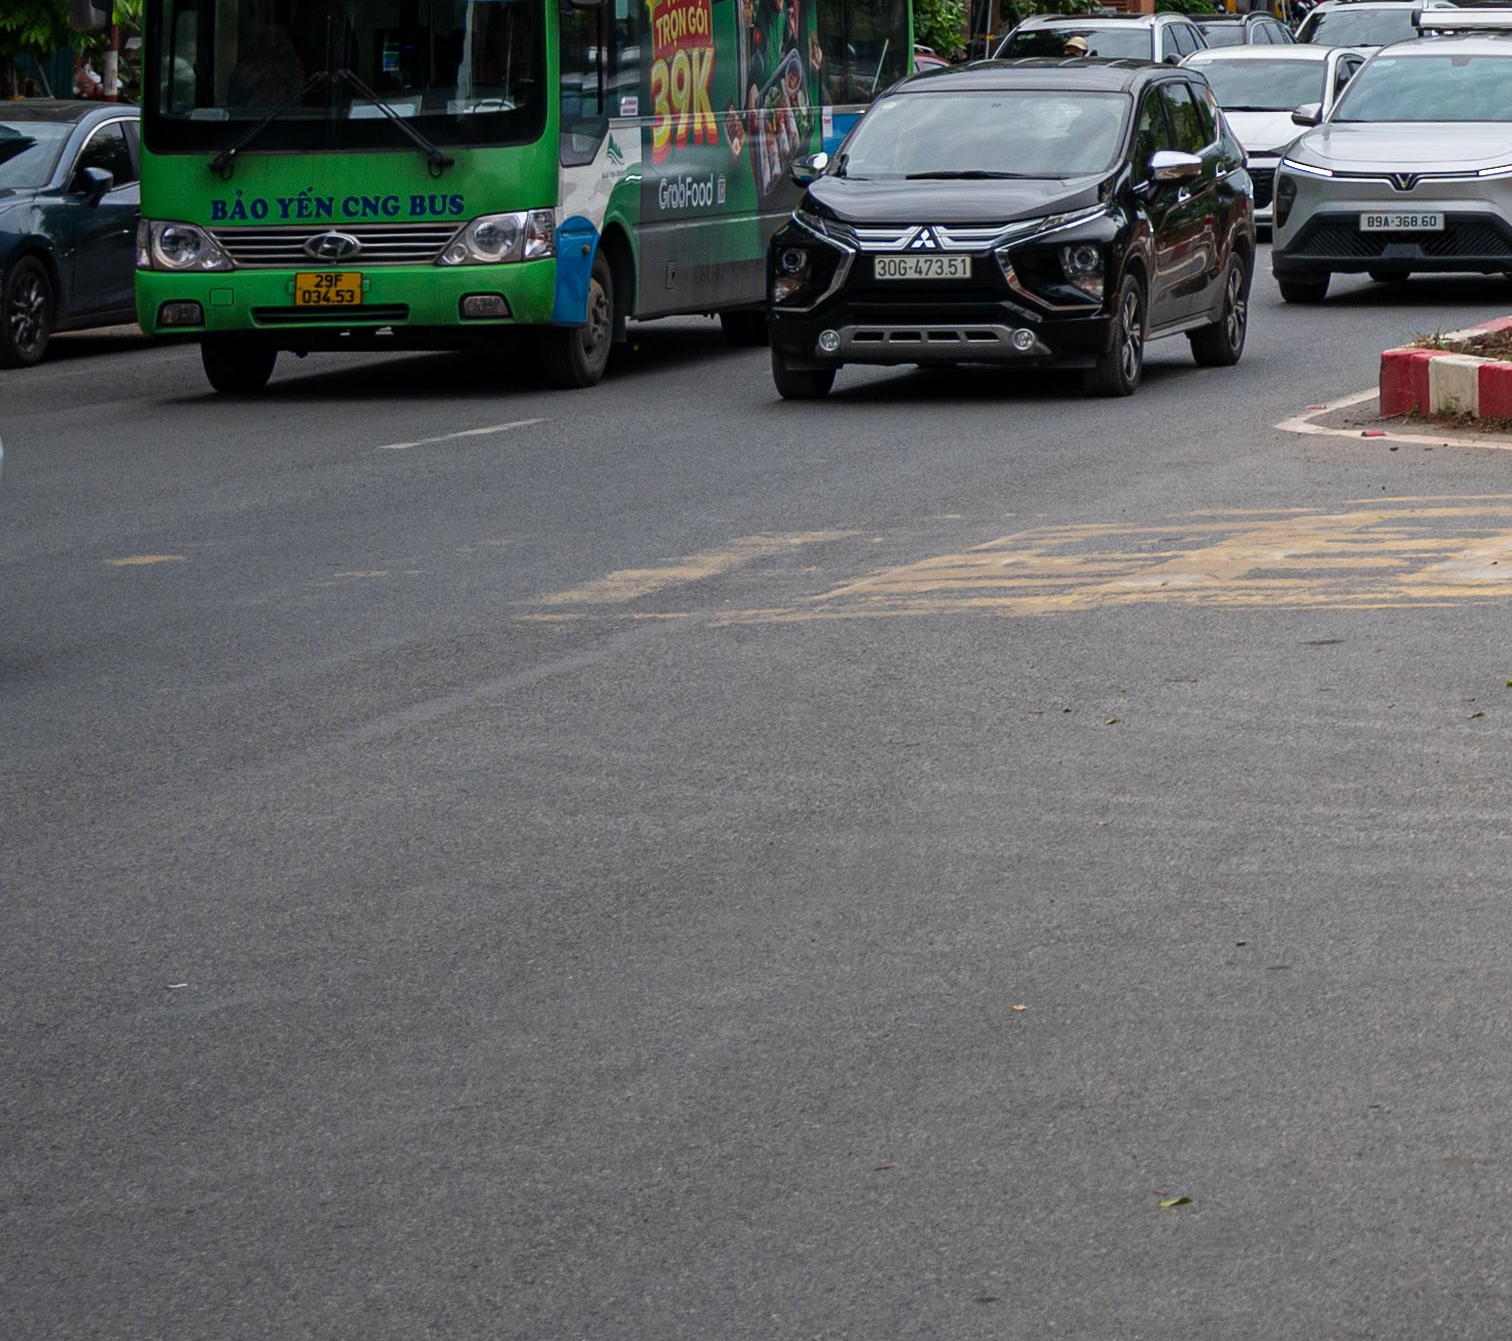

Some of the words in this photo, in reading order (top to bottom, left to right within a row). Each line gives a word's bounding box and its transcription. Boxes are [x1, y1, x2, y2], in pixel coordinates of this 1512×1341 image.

[655, 9, 686, 50] TRỌN
[687, 2, 709, 36] GÓI
[651, 47, 719, 163] 39K
[211, 189, 269, 222] BẢO
[277, 186, 335, 219] YẾN
[342, 194, 401, 218] CNG
[408, 193, 465, 218] BUS
[658, 175, 714, 210] GrabFood
[314, 274, 344, 289] 29F
[875, 258, 971, 279] 30G-473.51
[302, 289, 355, 304] 034.53
